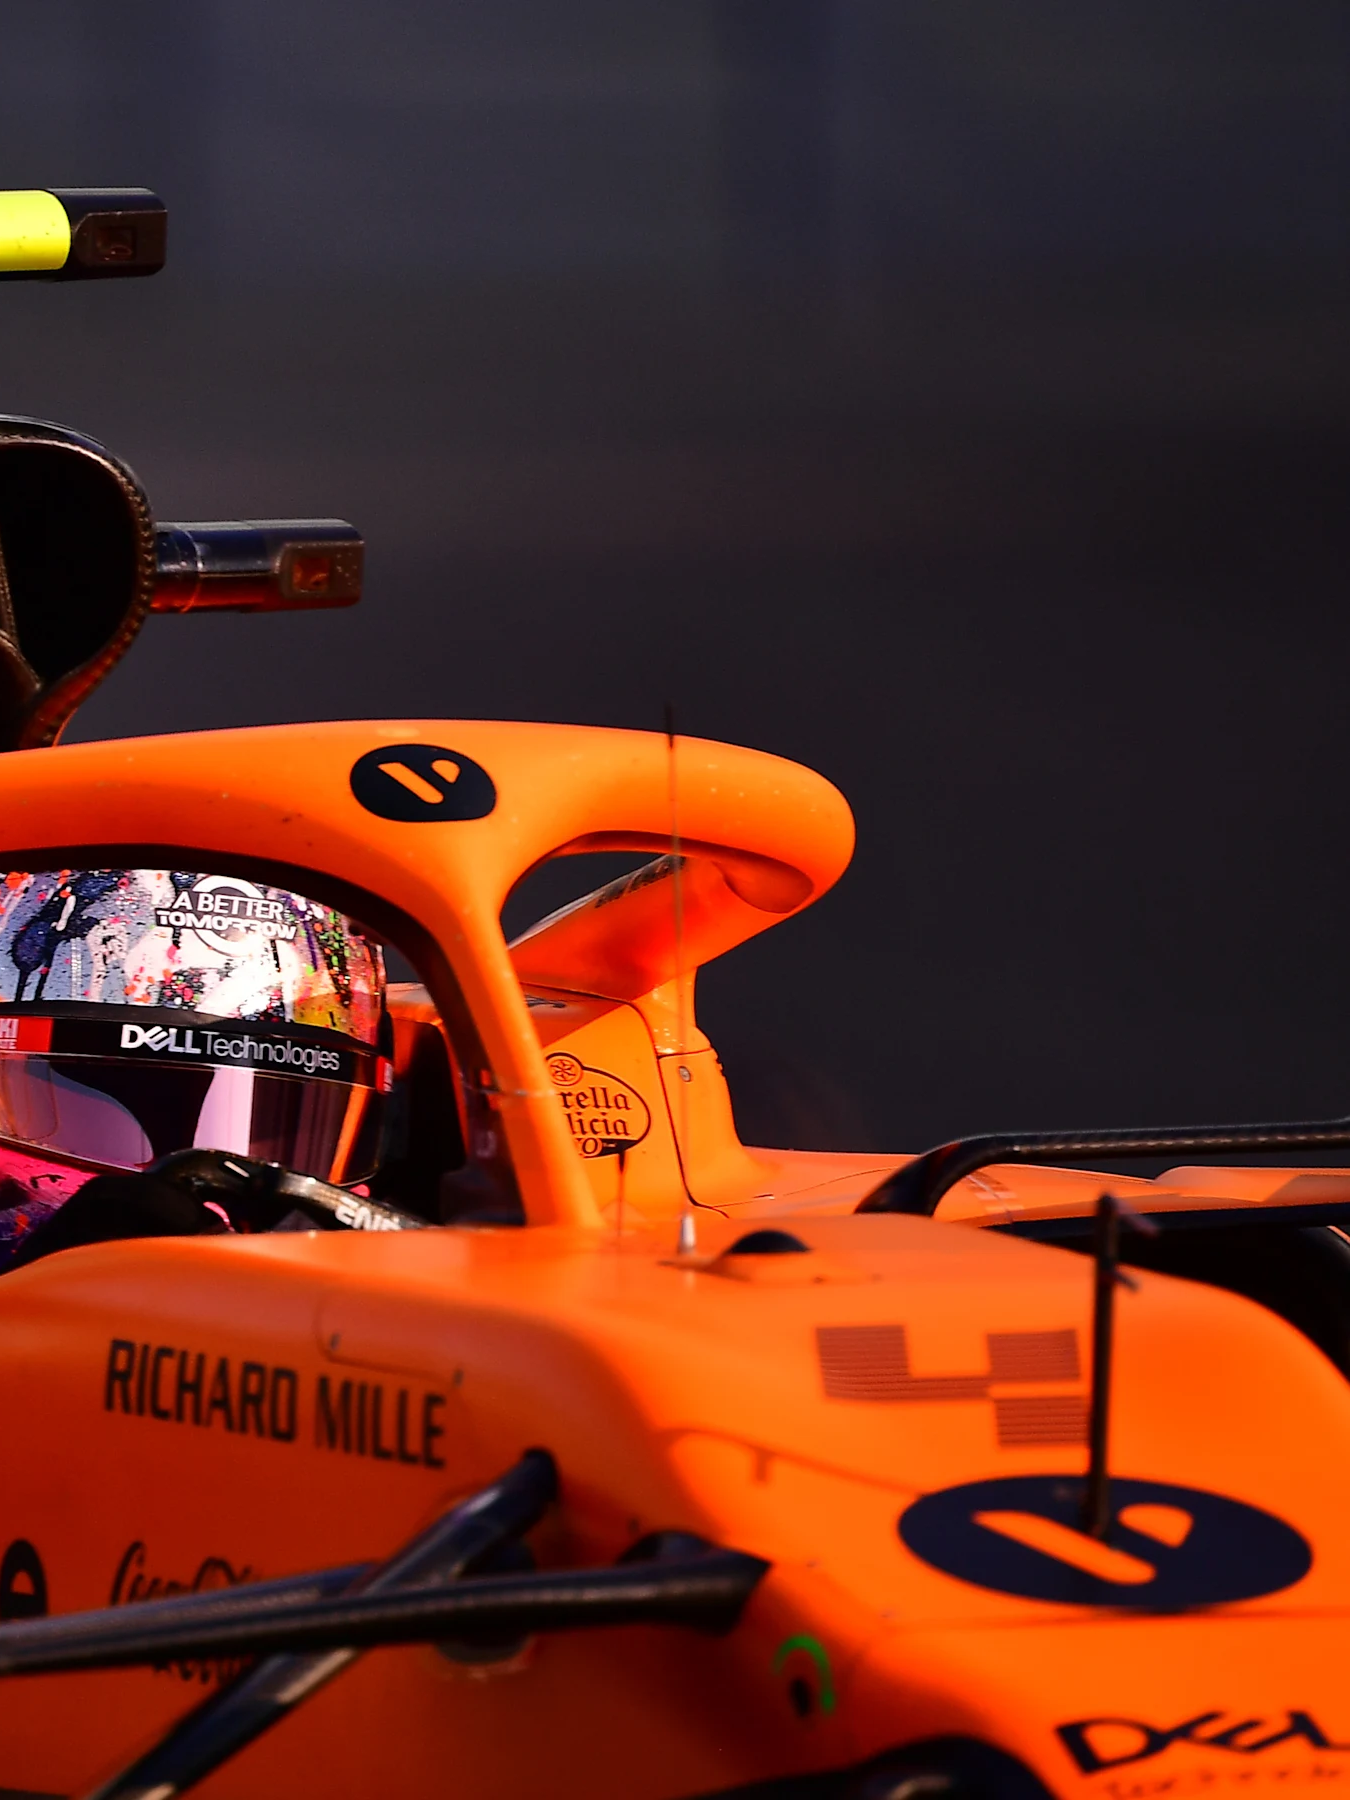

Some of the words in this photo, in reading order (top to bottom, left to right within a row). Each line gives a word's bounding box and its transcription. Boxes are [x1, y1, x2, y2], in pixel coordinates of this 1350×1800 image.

[172, 891, 193, 910] A
[197, 892, 284, 922] BETTER
[156, 910, 297, 940] TOMORROW
[120, 1024, 201, 1054] DELL
[201, 1031, 340, 1073] Technologies
[557, 1087, 632, 1111] rella
[564, 1111, 631, 1136] licia
[104, 1338, 298, 1443] RICHARD
[314, 1374, 446, 1469] MILLE
[1055, 1708, 1350, 1777] DEL
